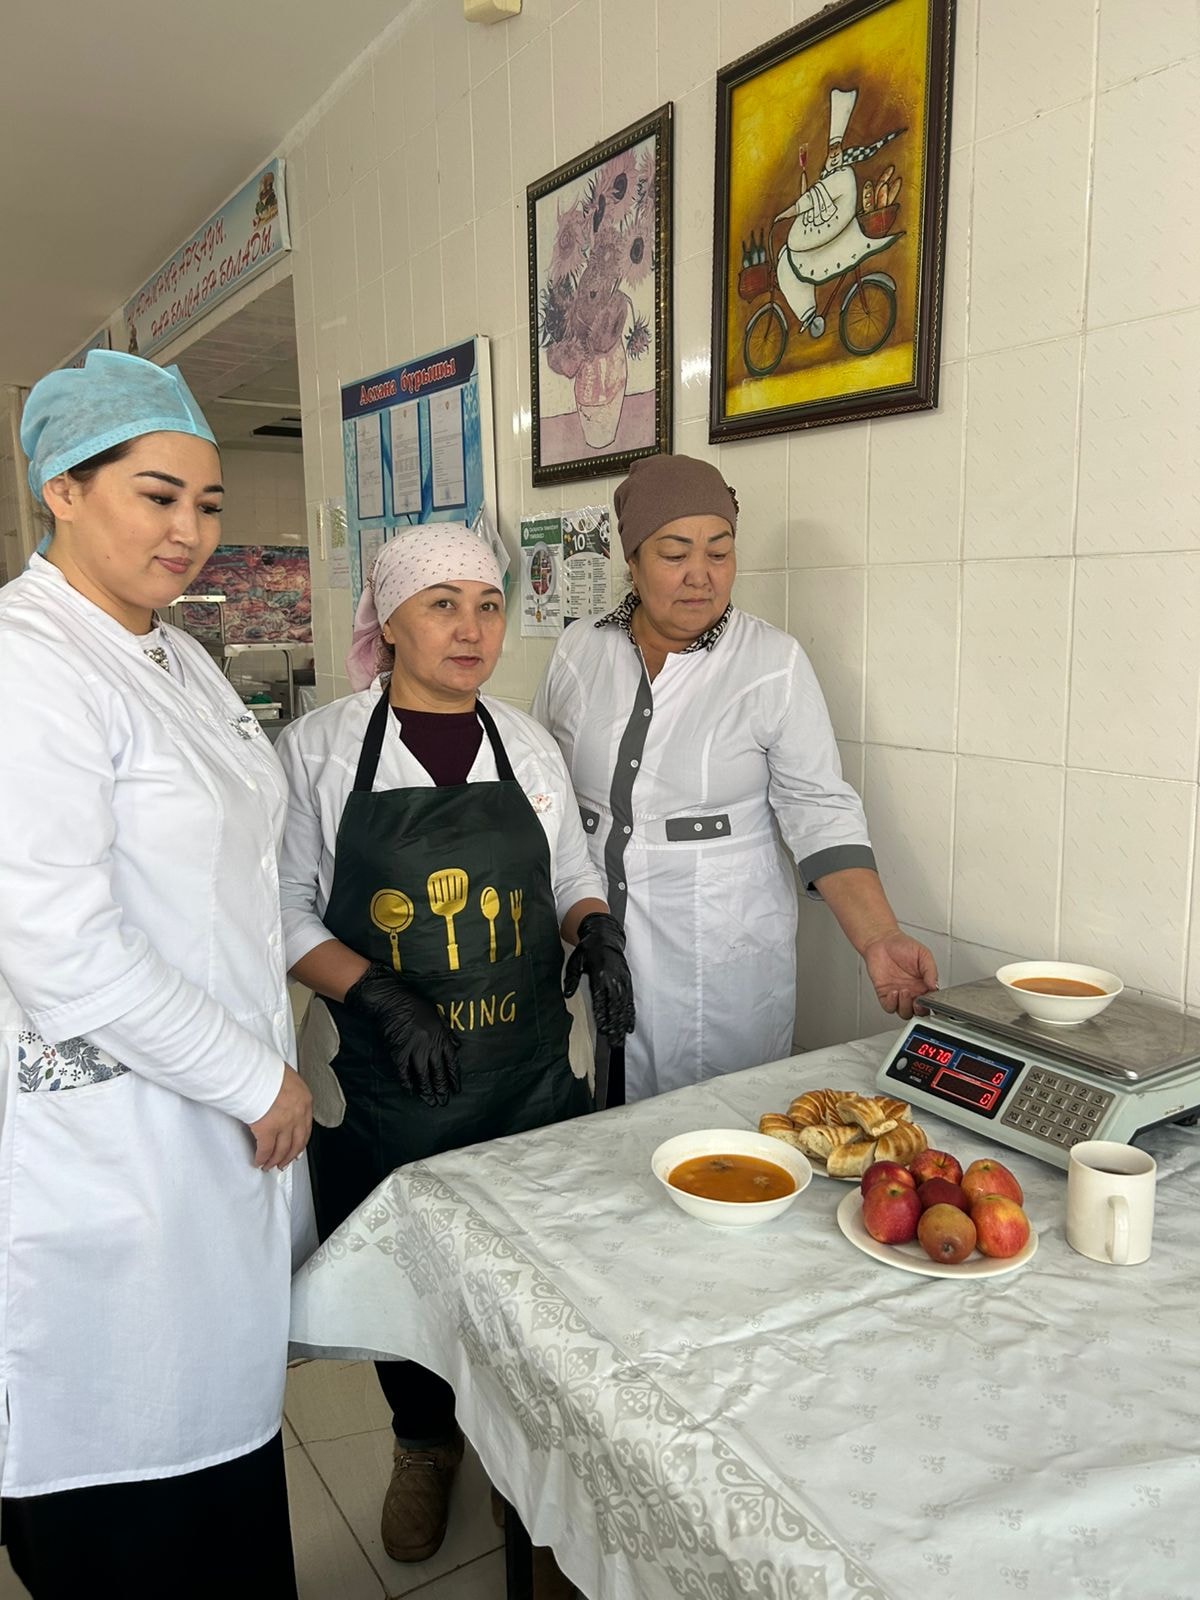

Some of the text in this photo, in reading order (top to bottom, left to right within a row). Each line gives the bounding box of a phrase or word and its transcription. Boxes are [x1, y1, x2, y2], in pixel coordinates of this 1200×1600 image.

[572, 533, 586, 551] 10
[437, 991, 517, 1031] KING
[992, 1072, 1004, 1085] 0
[979, 1093, 991, 1105] 0
